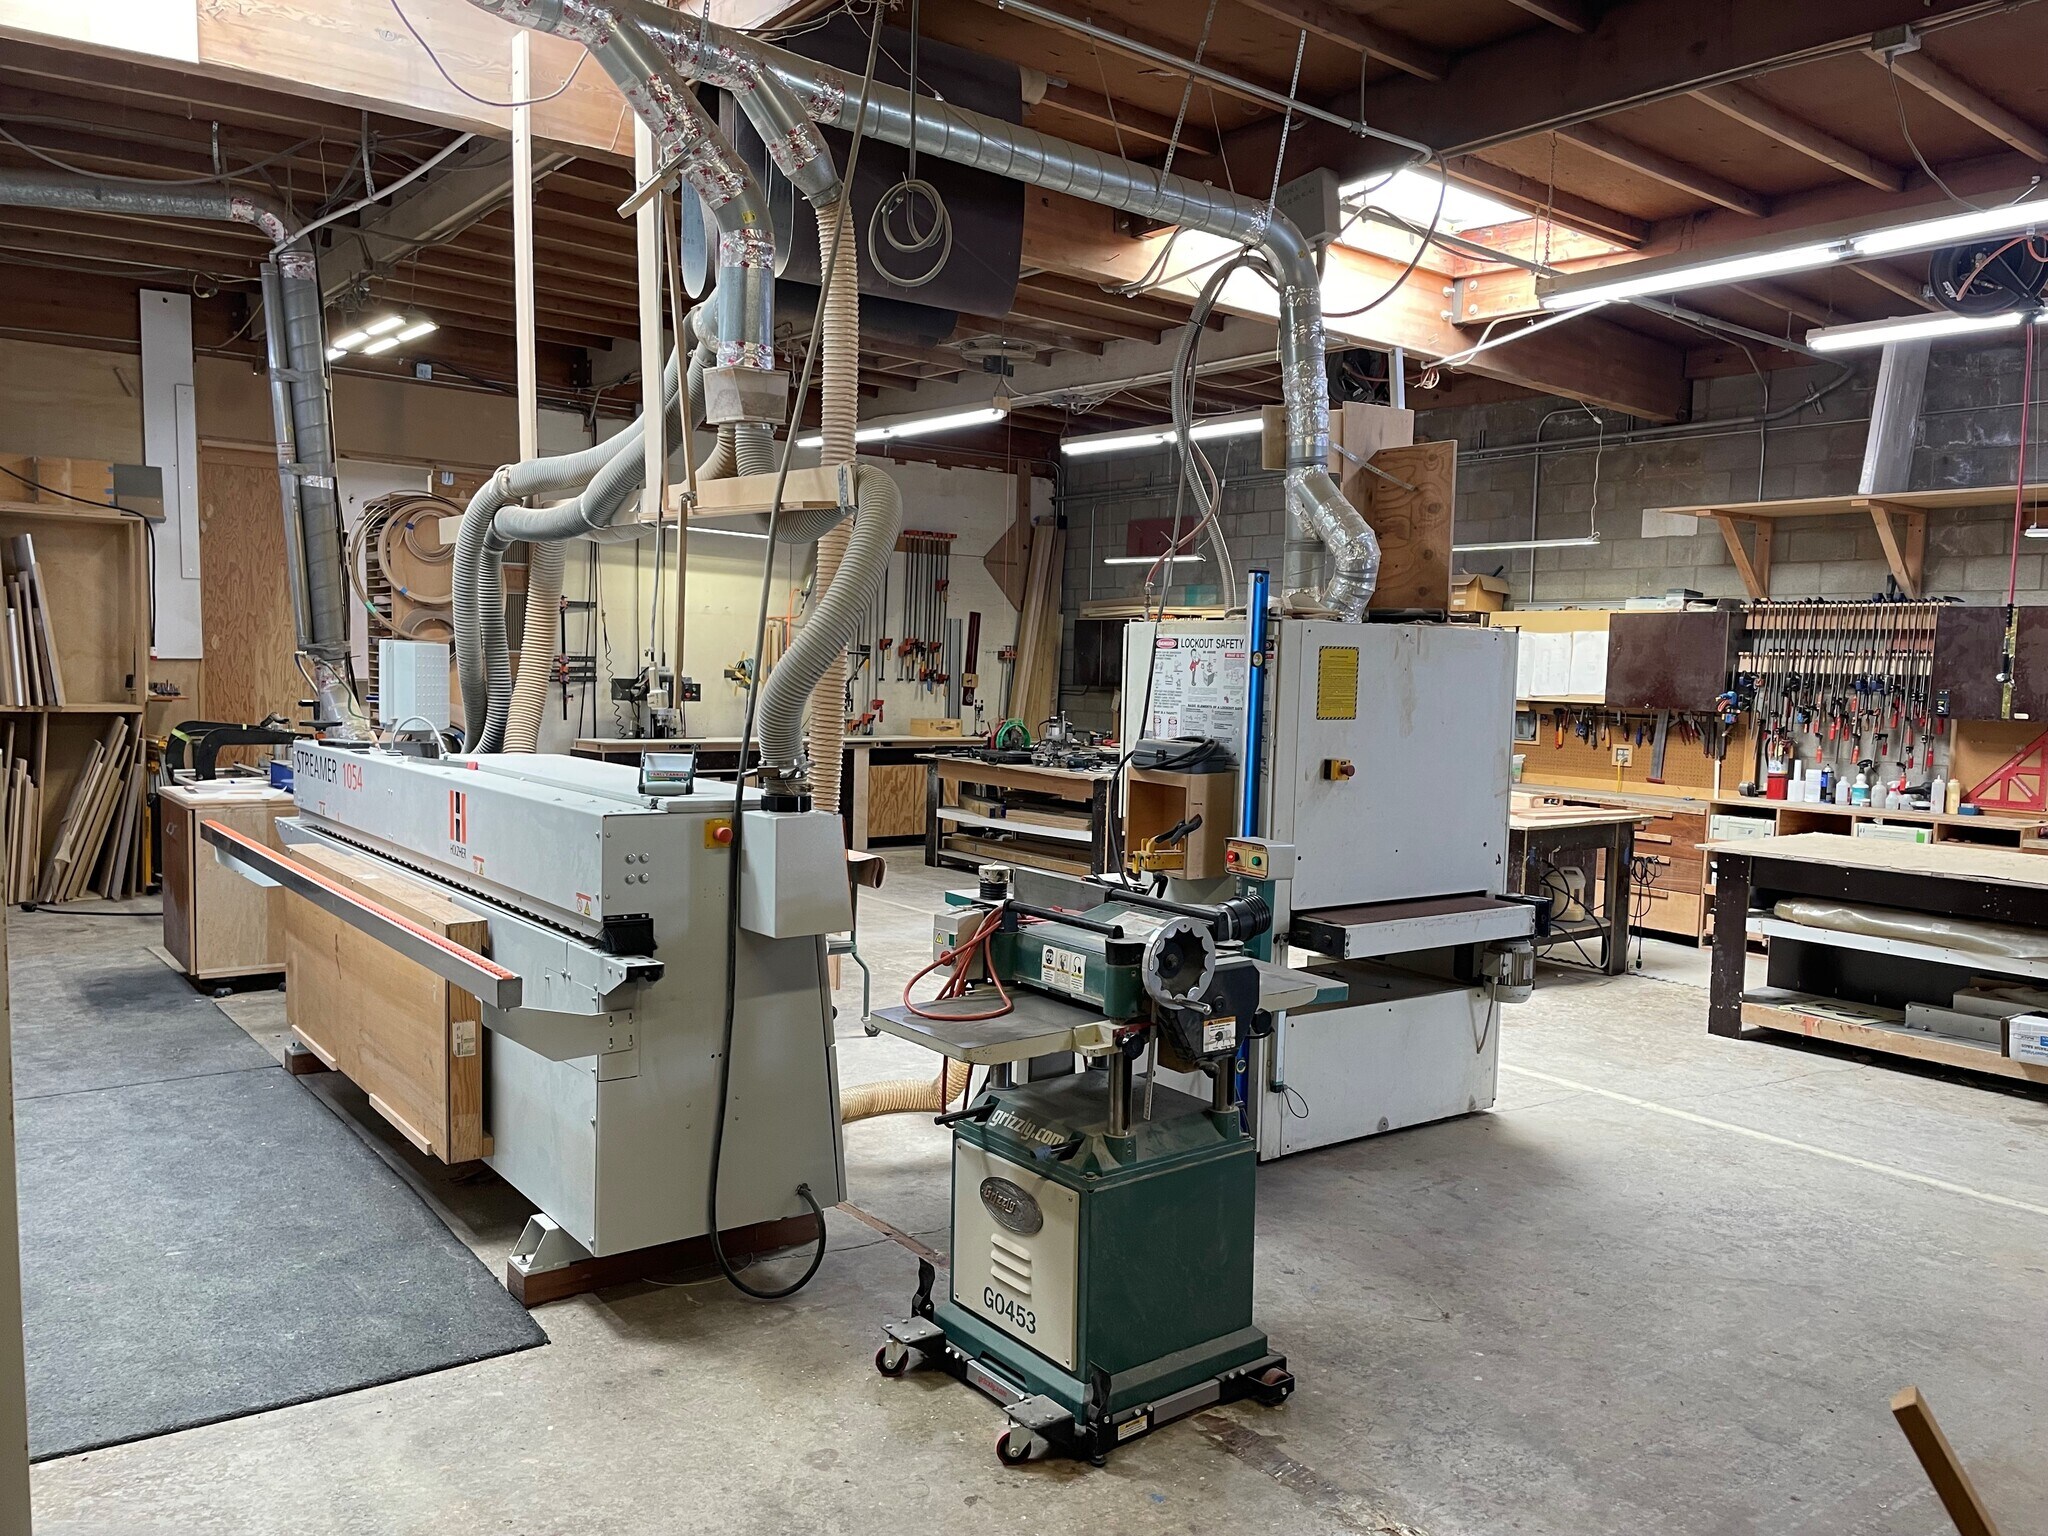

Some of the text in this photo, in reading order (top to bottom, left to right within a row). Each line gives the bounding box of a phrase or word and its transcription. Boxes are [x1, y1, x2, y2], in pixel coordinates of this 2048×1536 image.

[1181, 638, 1245, 649] LOCKOUT SAFETY
[297, 750, 363, 792] STREAMER 1054
[989, 1110, 1065, 1145] grizzly.com
[983, 1184, 1016, 1213] Grizzly
[983, 1286, 1036, 1335] G0453
